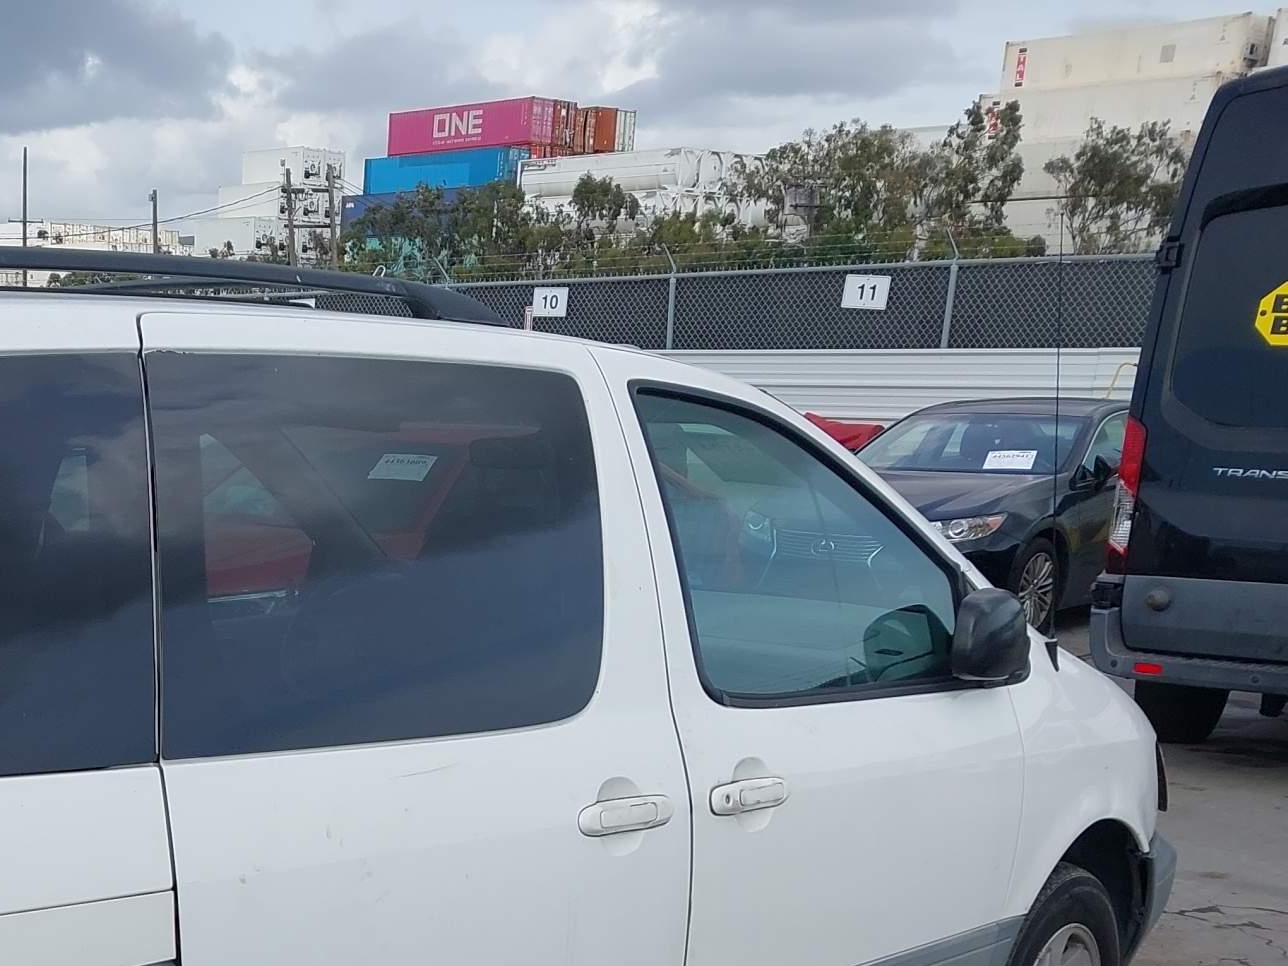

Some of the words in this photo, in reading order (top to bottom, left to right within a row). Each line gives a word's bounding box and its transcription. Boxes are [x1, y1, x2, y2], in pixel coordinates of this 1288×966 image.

[432, 109, 484, 138] ONE
[857, 283, 877, 301] 11
[541, 294, 559, 310] 10
